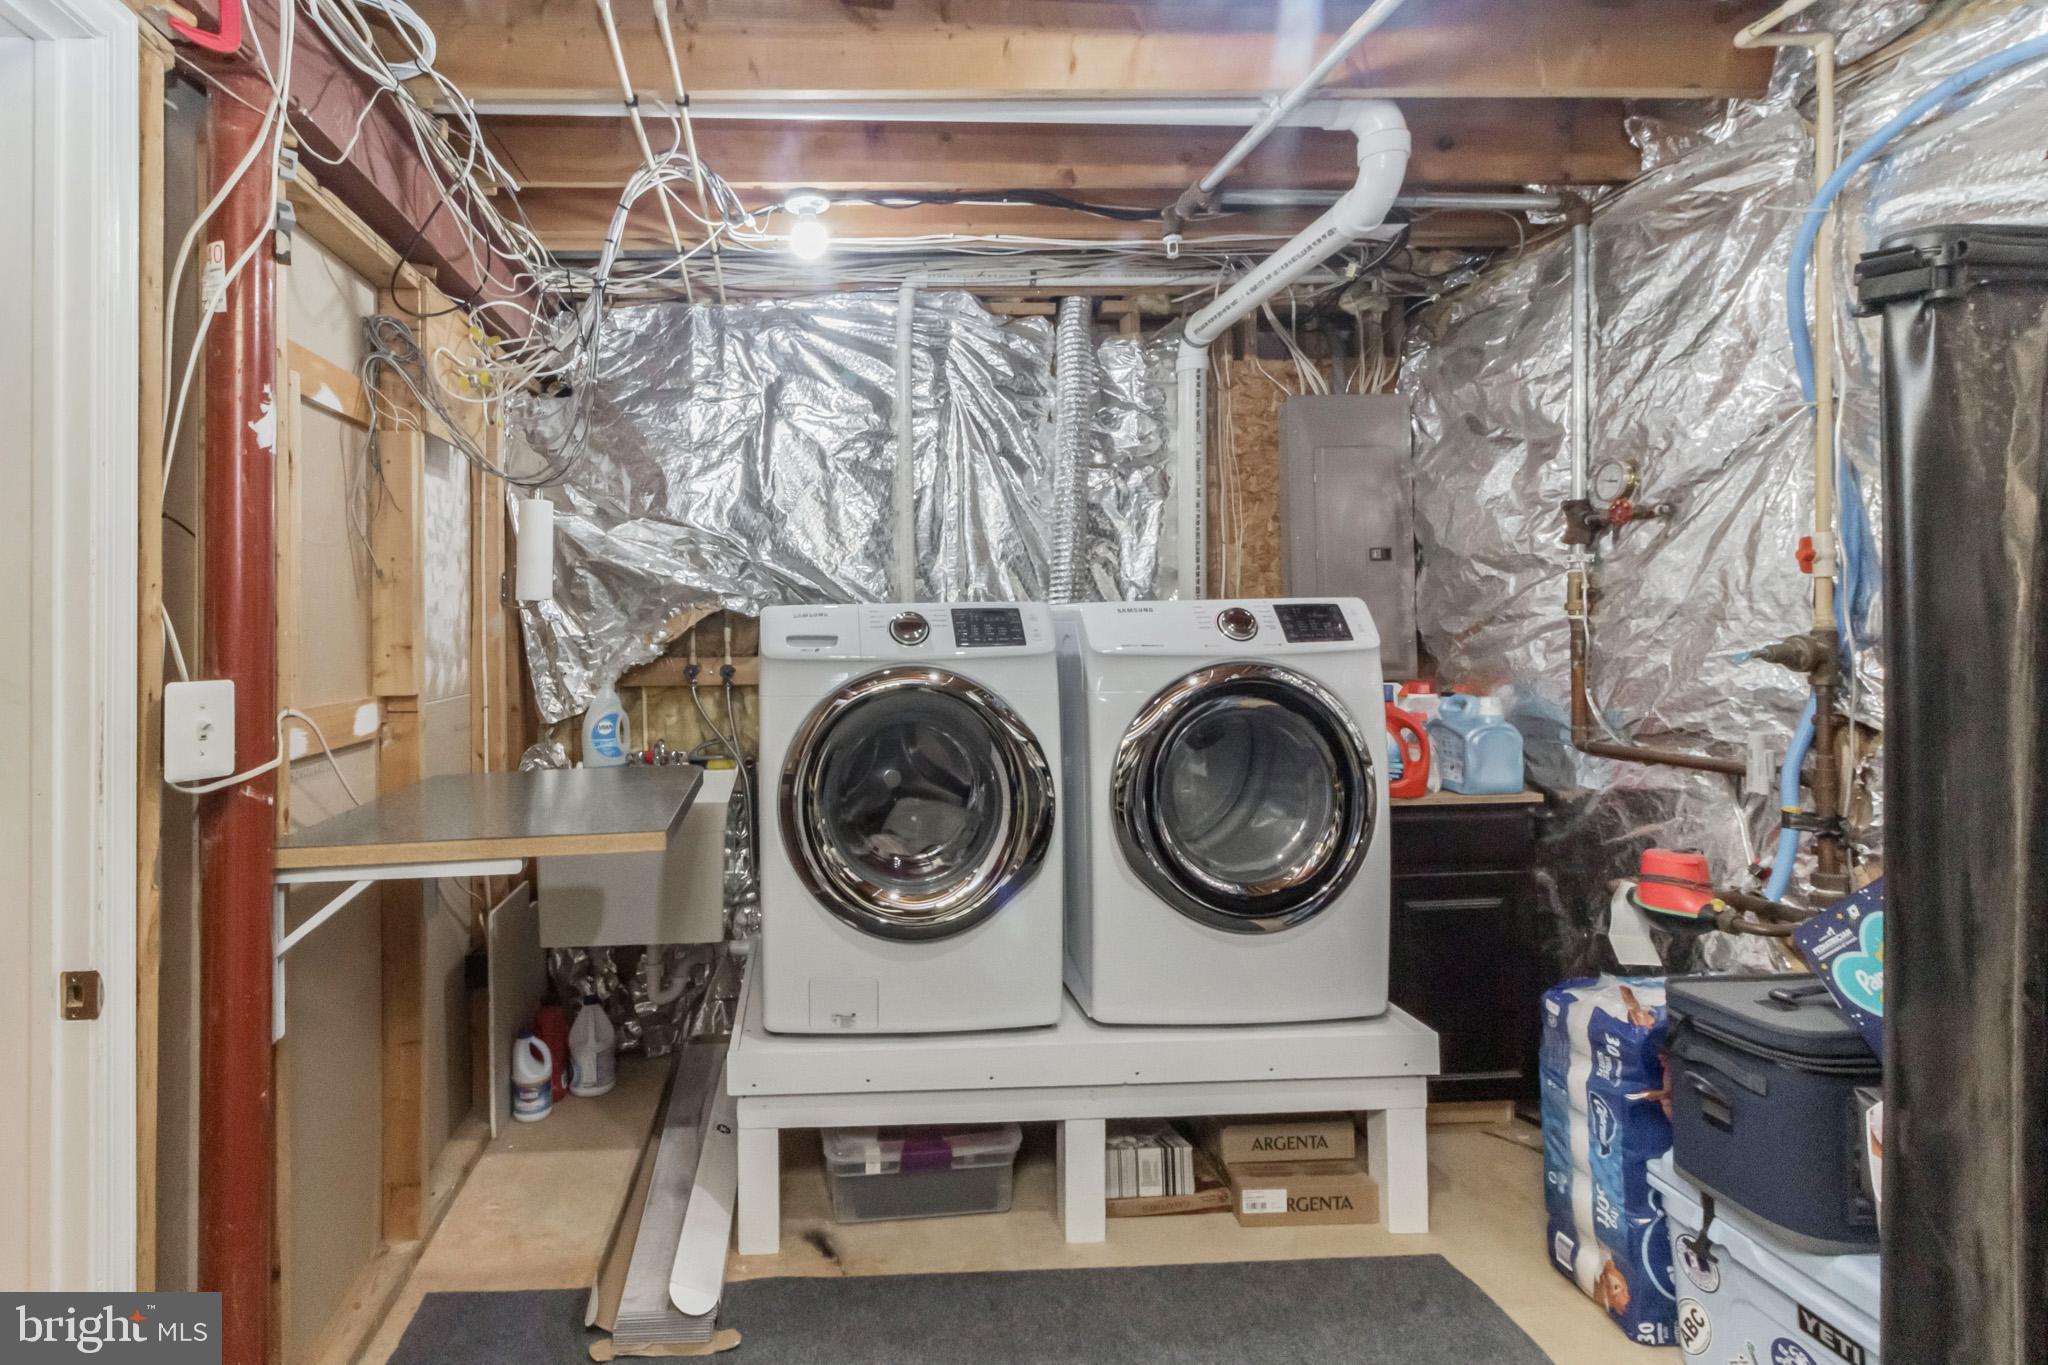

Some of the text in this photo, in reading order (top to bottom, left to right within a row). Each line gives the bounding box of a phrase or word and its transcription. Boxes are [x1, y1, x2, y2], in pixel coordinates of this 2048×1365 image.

[1605, 1033, 1621, 1057] 30
[1251, 1135, 1329, 1151] ARGENTA
[1287, 1195, 1354, 1213] RGENTA
[1638, 1322, 1656, 1345] 30
[1680, 1307, 1705, 1348] ABC
[1801, 1311, 1862, 1365] YETI
